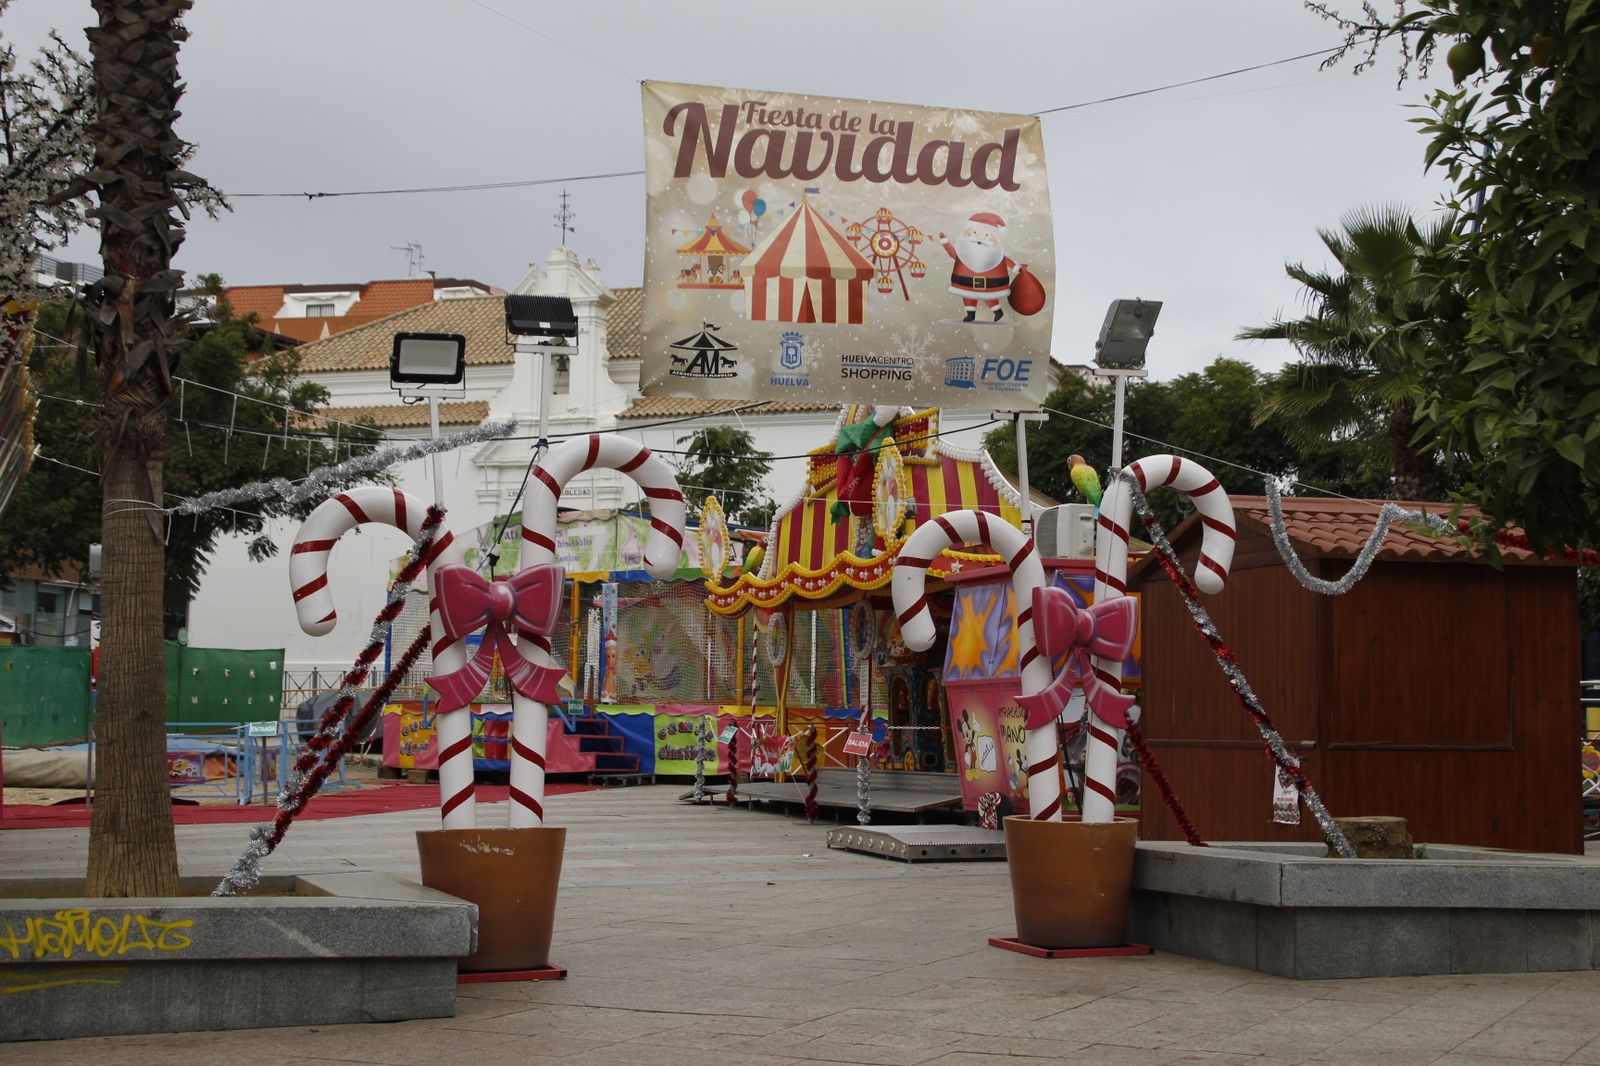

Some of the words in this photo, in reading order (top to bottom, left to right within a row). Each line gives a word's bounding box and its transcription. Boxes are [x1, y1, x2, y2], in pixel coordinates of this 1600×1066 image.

[741, 100, 823, 129] Fiesta
[829, 110, 862, 133] de
[869, 113, 896, 136] la
[662, 101, 1021, 192] Navidad
[841, 367, 912, 381] SHOPPING
[980, 358, 1032, 382] FOE
[770, 377, 809, 387] HUELVA
[847, 738, 869, 748] SALIDA
